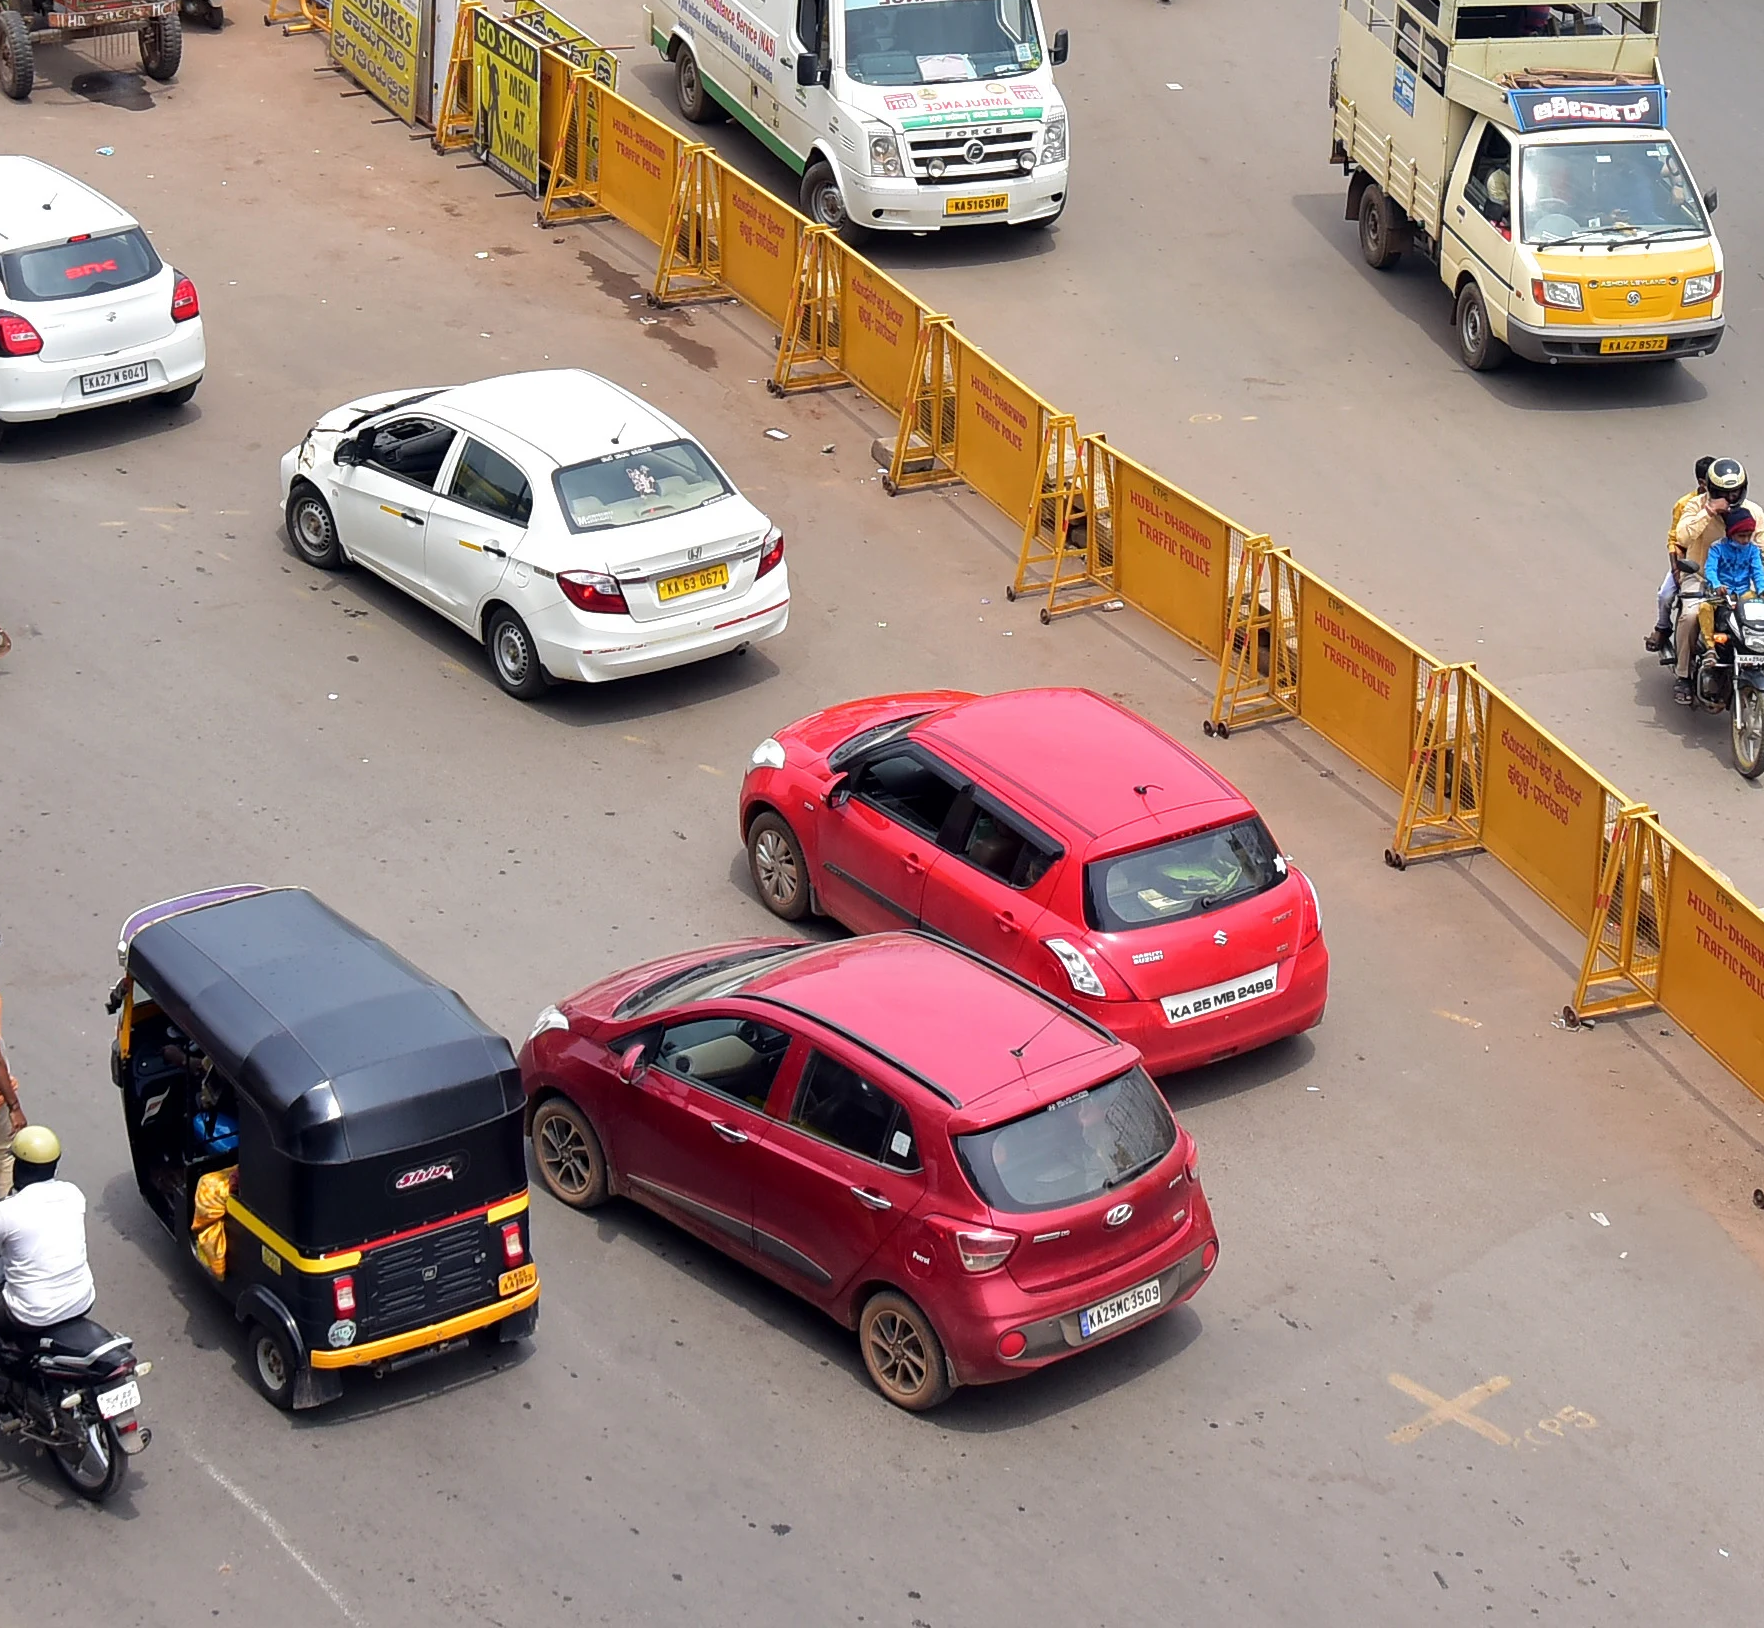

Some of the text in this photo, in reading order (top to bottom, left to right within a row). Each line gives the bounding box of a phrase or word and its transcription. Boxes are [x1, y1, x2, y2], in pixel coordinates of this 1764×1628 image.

[476, 14, 536, 75] GO SLOW
[736, 11, 758, 45] Service
[758, 29, 776, 62] (NAS)
[508, 73, 531, 109] MEN
[512, 108, 526, 136] AT
[945, 126, 1003, 138] FORCE
[504, 130, 536, 174] WORK
[1600, 278, 1667, 288] ASHOK LEYLAND
[1609, 338, 1665, 352] KA 47 8572
[88, 373, 112, 390] KA27
[122, 367, 146, 383] 6041
[970, 374, 1028, 431] HUBLI-DHARWAD
[975, 401, 1023, 453] TRAFFIC POLICE
[1130, 490, 1211, 550] HUBLI-DHARWAD
[1137, 518, 1211, 578] TRAFFIC POLICE
[667, 569, 725, 594] KA 63 0671
[1314, 609, 1397, 678] HUBLI-DHARWAD
[1322, 641, 1391, 702] TRAFFIC POLICE
[1132, 950, 1163, 960] MARUTI
[1133, 954, 1164, 965] SUZUKI
[1695, 925, 1739, 975] TRAFFIC
[1170, 978, 1274, 1021] KA 25 MB 2499
[912, 1251, 931, 1266] Petrol
[1088, 1284, 1160, 1329] KA25MC3509
